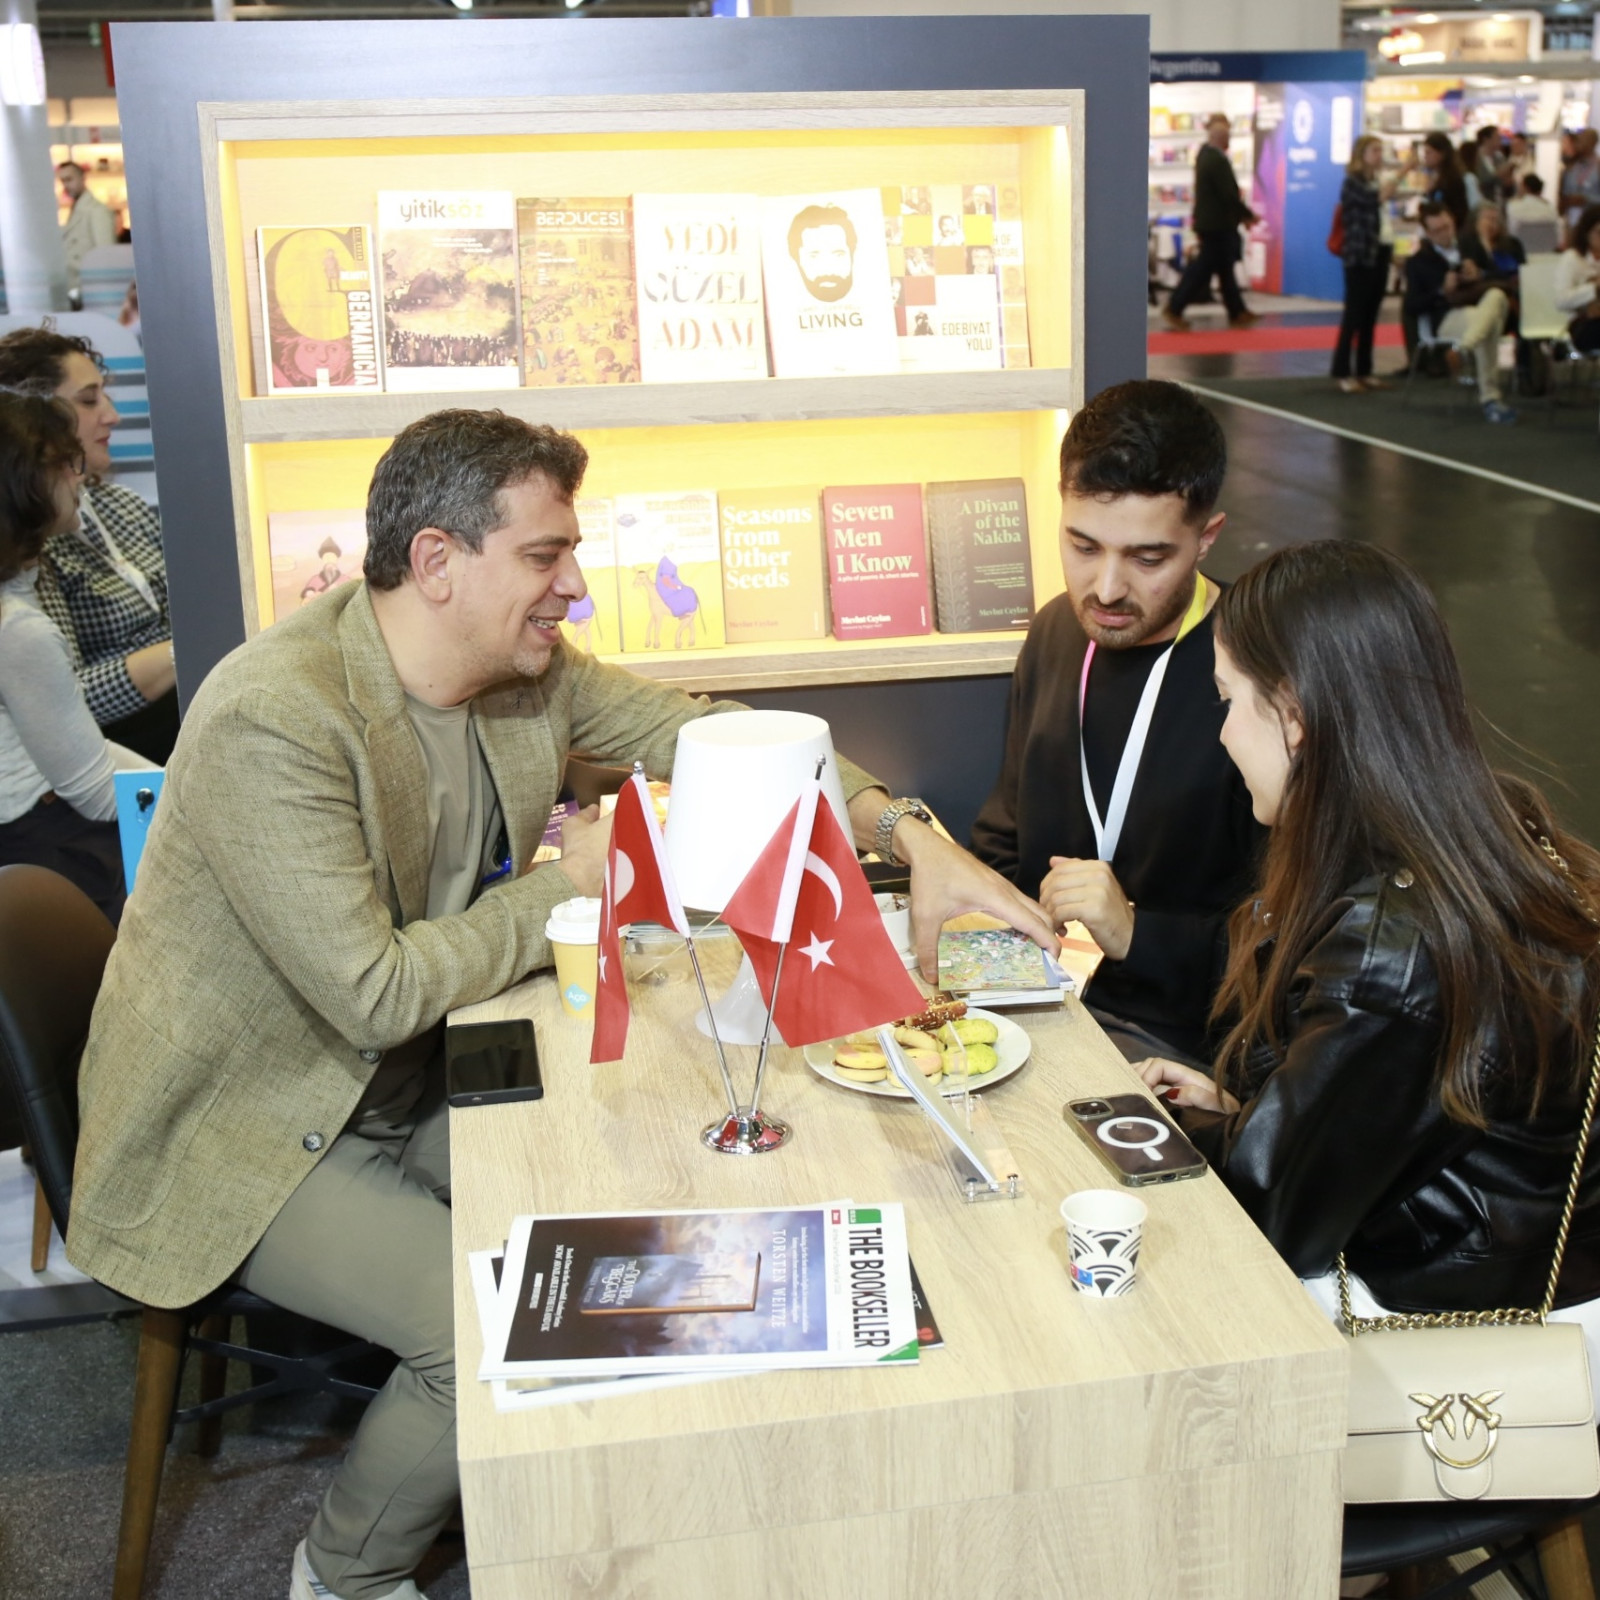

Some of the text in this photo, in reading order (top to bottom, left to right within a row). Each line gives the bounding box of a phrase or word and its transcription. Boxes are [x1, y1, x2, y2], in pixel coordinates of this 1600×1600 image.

[798, 311, 864, 329] LIVING
[941, 319, 991, 336] EDEBİYAT
[348, 290, 377, 386] GERMANICIA
[966, 337, 993, 352] YOLU
[722, 505, 813, 527] Seasons
[832, 502, 894, 523] Seven
[961, 499, 1019, 515] A Divan
[975, 512, 1020, 530] of the
[723, 526, 781, 547] from
[834, 528, 882, 549] Men
[973, 530, 1022, 547] Nakba
[725, 546, 792, 568] Other
[836, 552, 912, 574] I Know
[726, 567, 790, 590] Seeds
[555, 1244, 565, 1260] NOW
[598, 1263, 625, 1304] BEGGARS
[771, 1229, 787, 1329] TORSTEN WEITZE
[849, 1227, 891, 1348] THE BOOKSELLER
